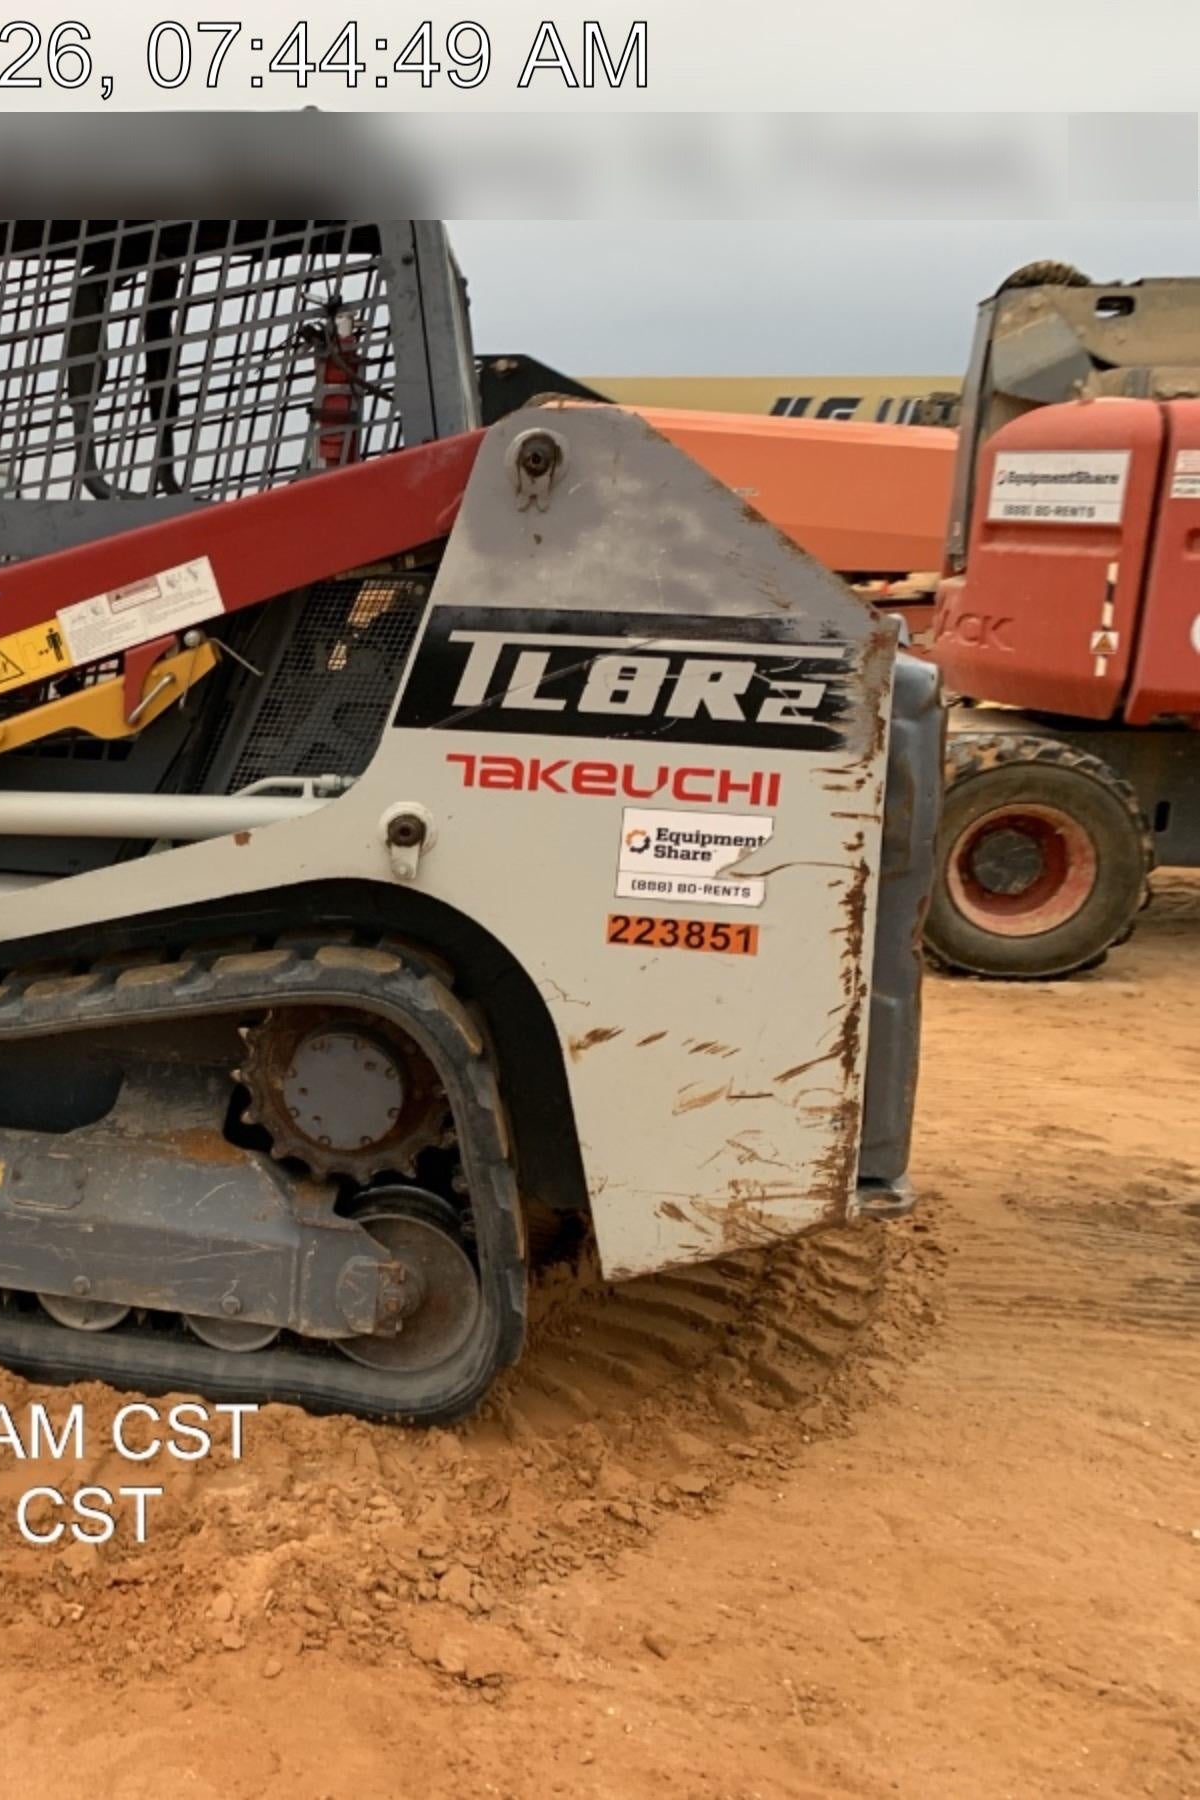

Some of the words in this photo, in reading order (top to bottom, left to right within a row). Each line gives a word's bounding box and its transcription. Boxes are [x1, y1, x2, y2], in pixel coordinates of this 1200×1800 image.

[446, 753, 781, 807] TAKEUCHI
[656, 827, 765, 848] Equipment
[653, 845, 713, 862] Share
[631, 879, 673, 894] (888)
[608, 915, 752, 953] 223851
